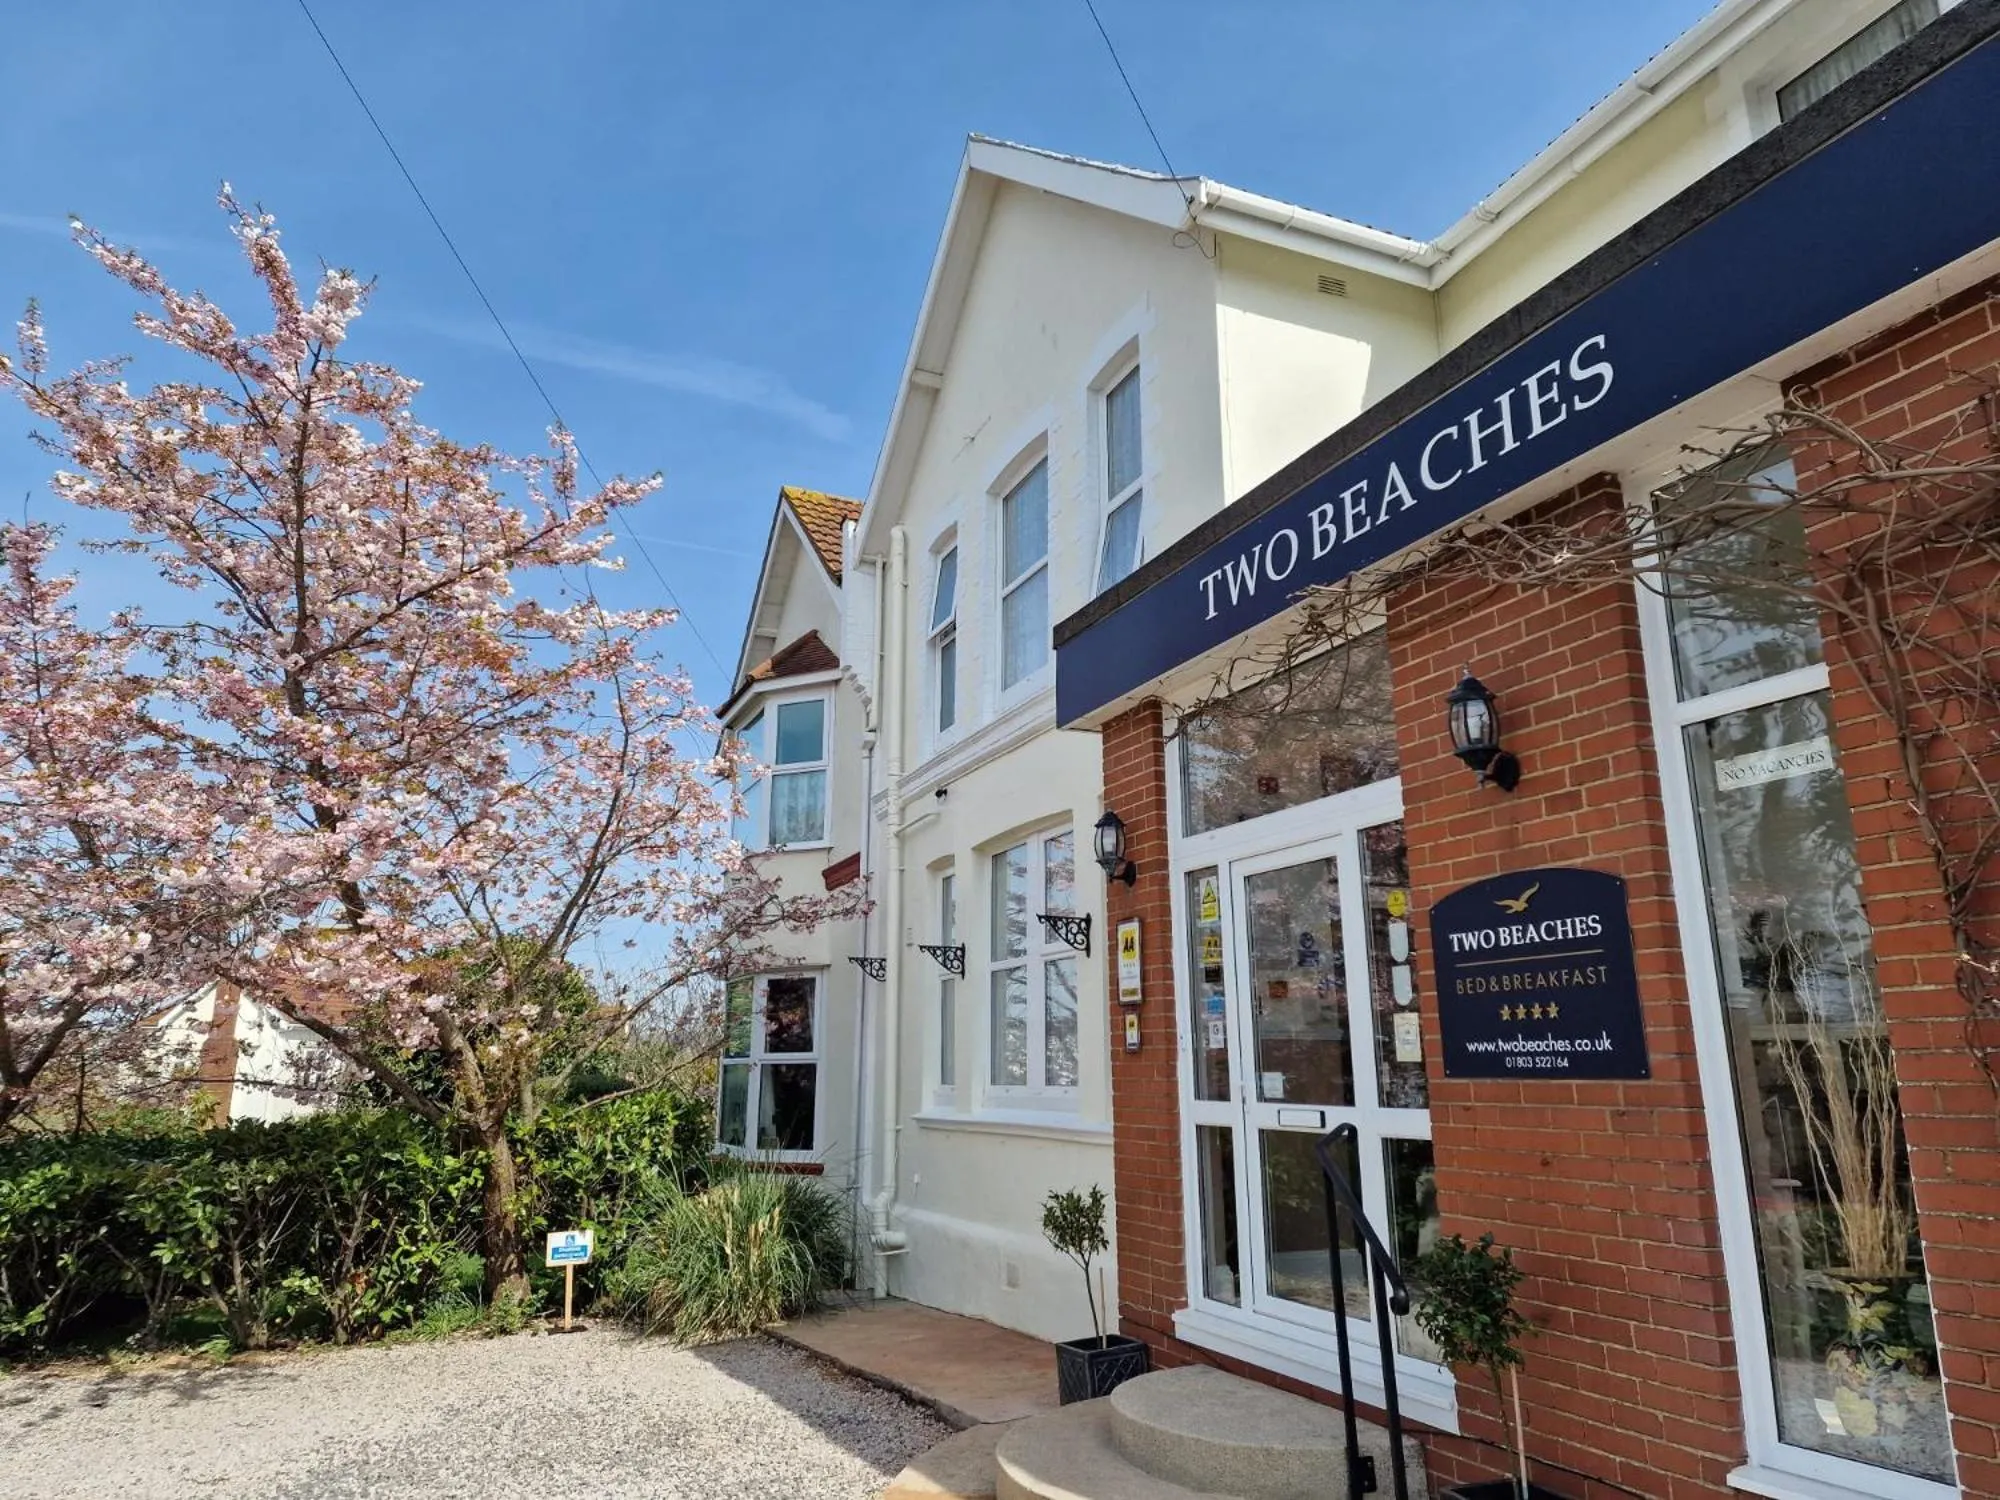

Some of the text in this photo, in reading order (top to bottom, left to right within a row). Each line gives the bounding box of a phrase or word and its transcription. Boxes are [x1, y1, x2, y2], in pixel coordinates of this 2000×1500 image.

[1199, 334, 1615, 621] TWO BEACHES
[1723, 750, 1825, 780] NO VACANCIES
[1449, 914, 1602, 953] TWO BEACHES
[1465, 1030, 1613, 1054] www.twobeaches.co.uk
[1505, 1056, 1569, 1068] 01803 522164
